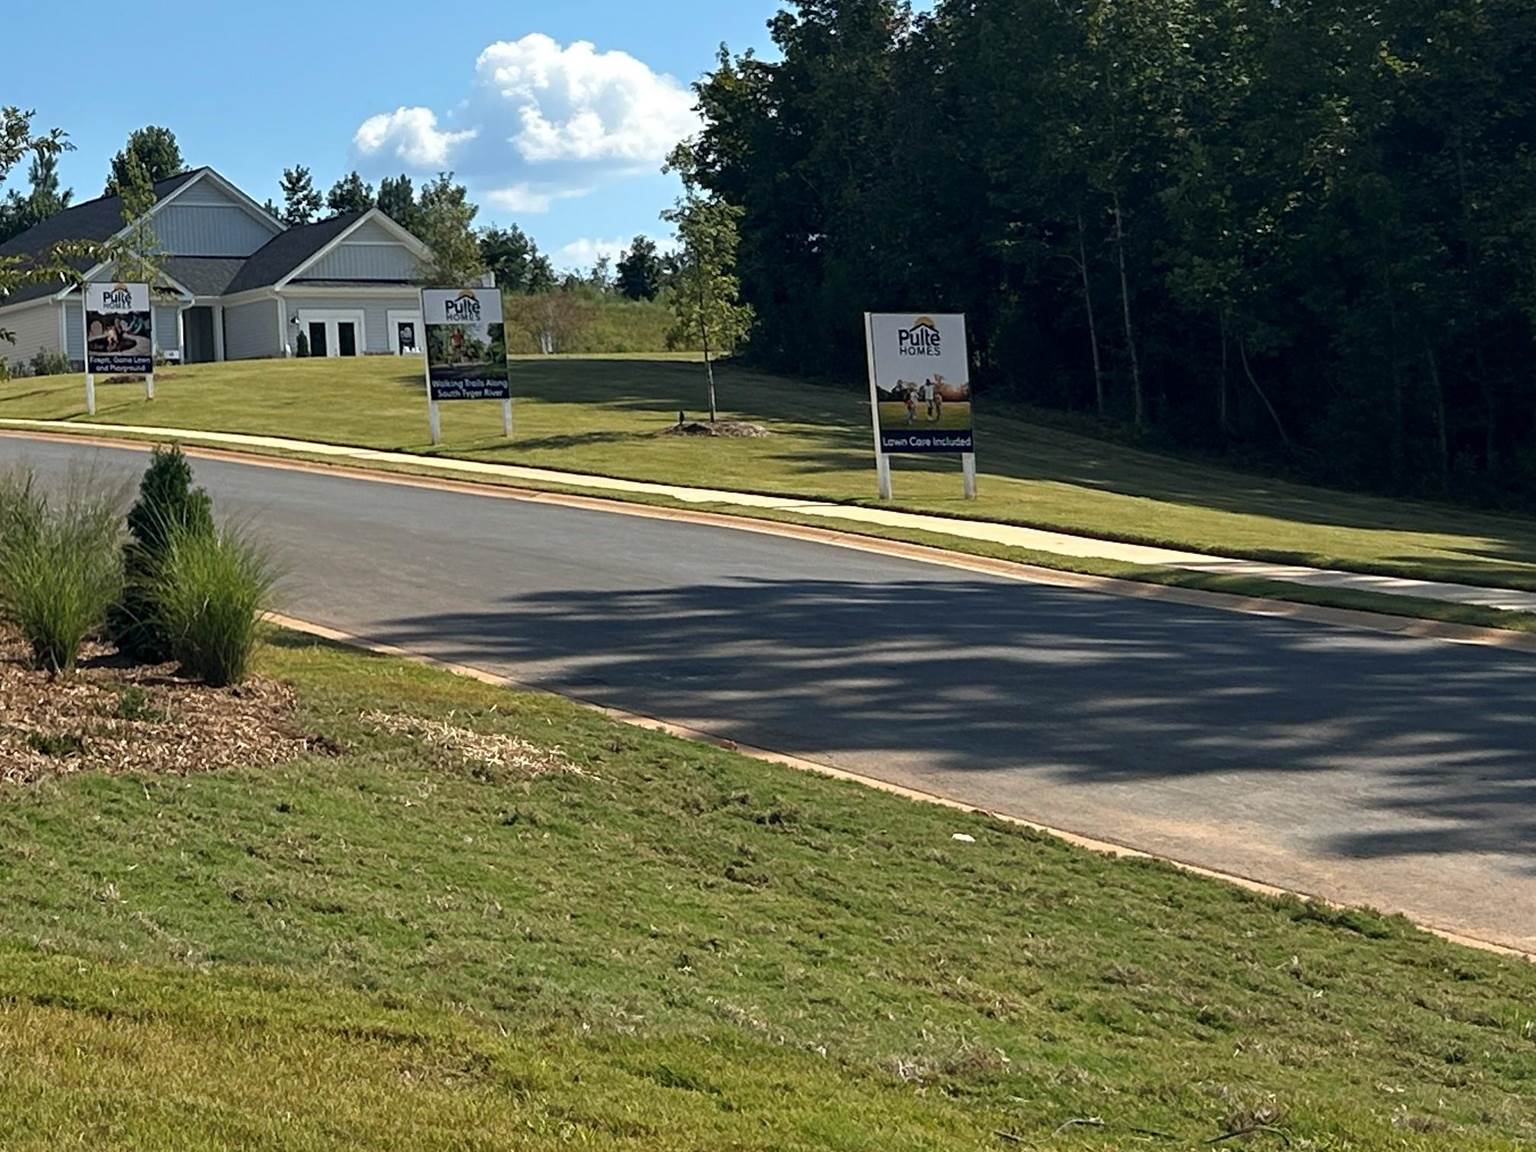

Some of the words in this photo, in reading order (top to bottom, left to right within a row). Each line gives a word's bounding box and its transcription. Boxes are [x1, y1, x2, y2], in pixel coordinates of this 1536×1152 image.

[103, 291, 132, 303] Pulte
[445, 299, 481, 314] Pulte
[446, 313, 481, 321] HOMES
[898, 328, 941, 346] Pulte
[899, 346, 941, 356] HOMES
[431, 379, 464, 389] Walking
[464, 379, 484, 387] Trails
[485, 379, 508, 389] Along
[437, 389, 461, 397] South
[484, 389, 503, 397] River
[883, 436, 908, 446] Lawn
[909, 436, 931, 446] Care
[932, 436, 971, 446] Included
